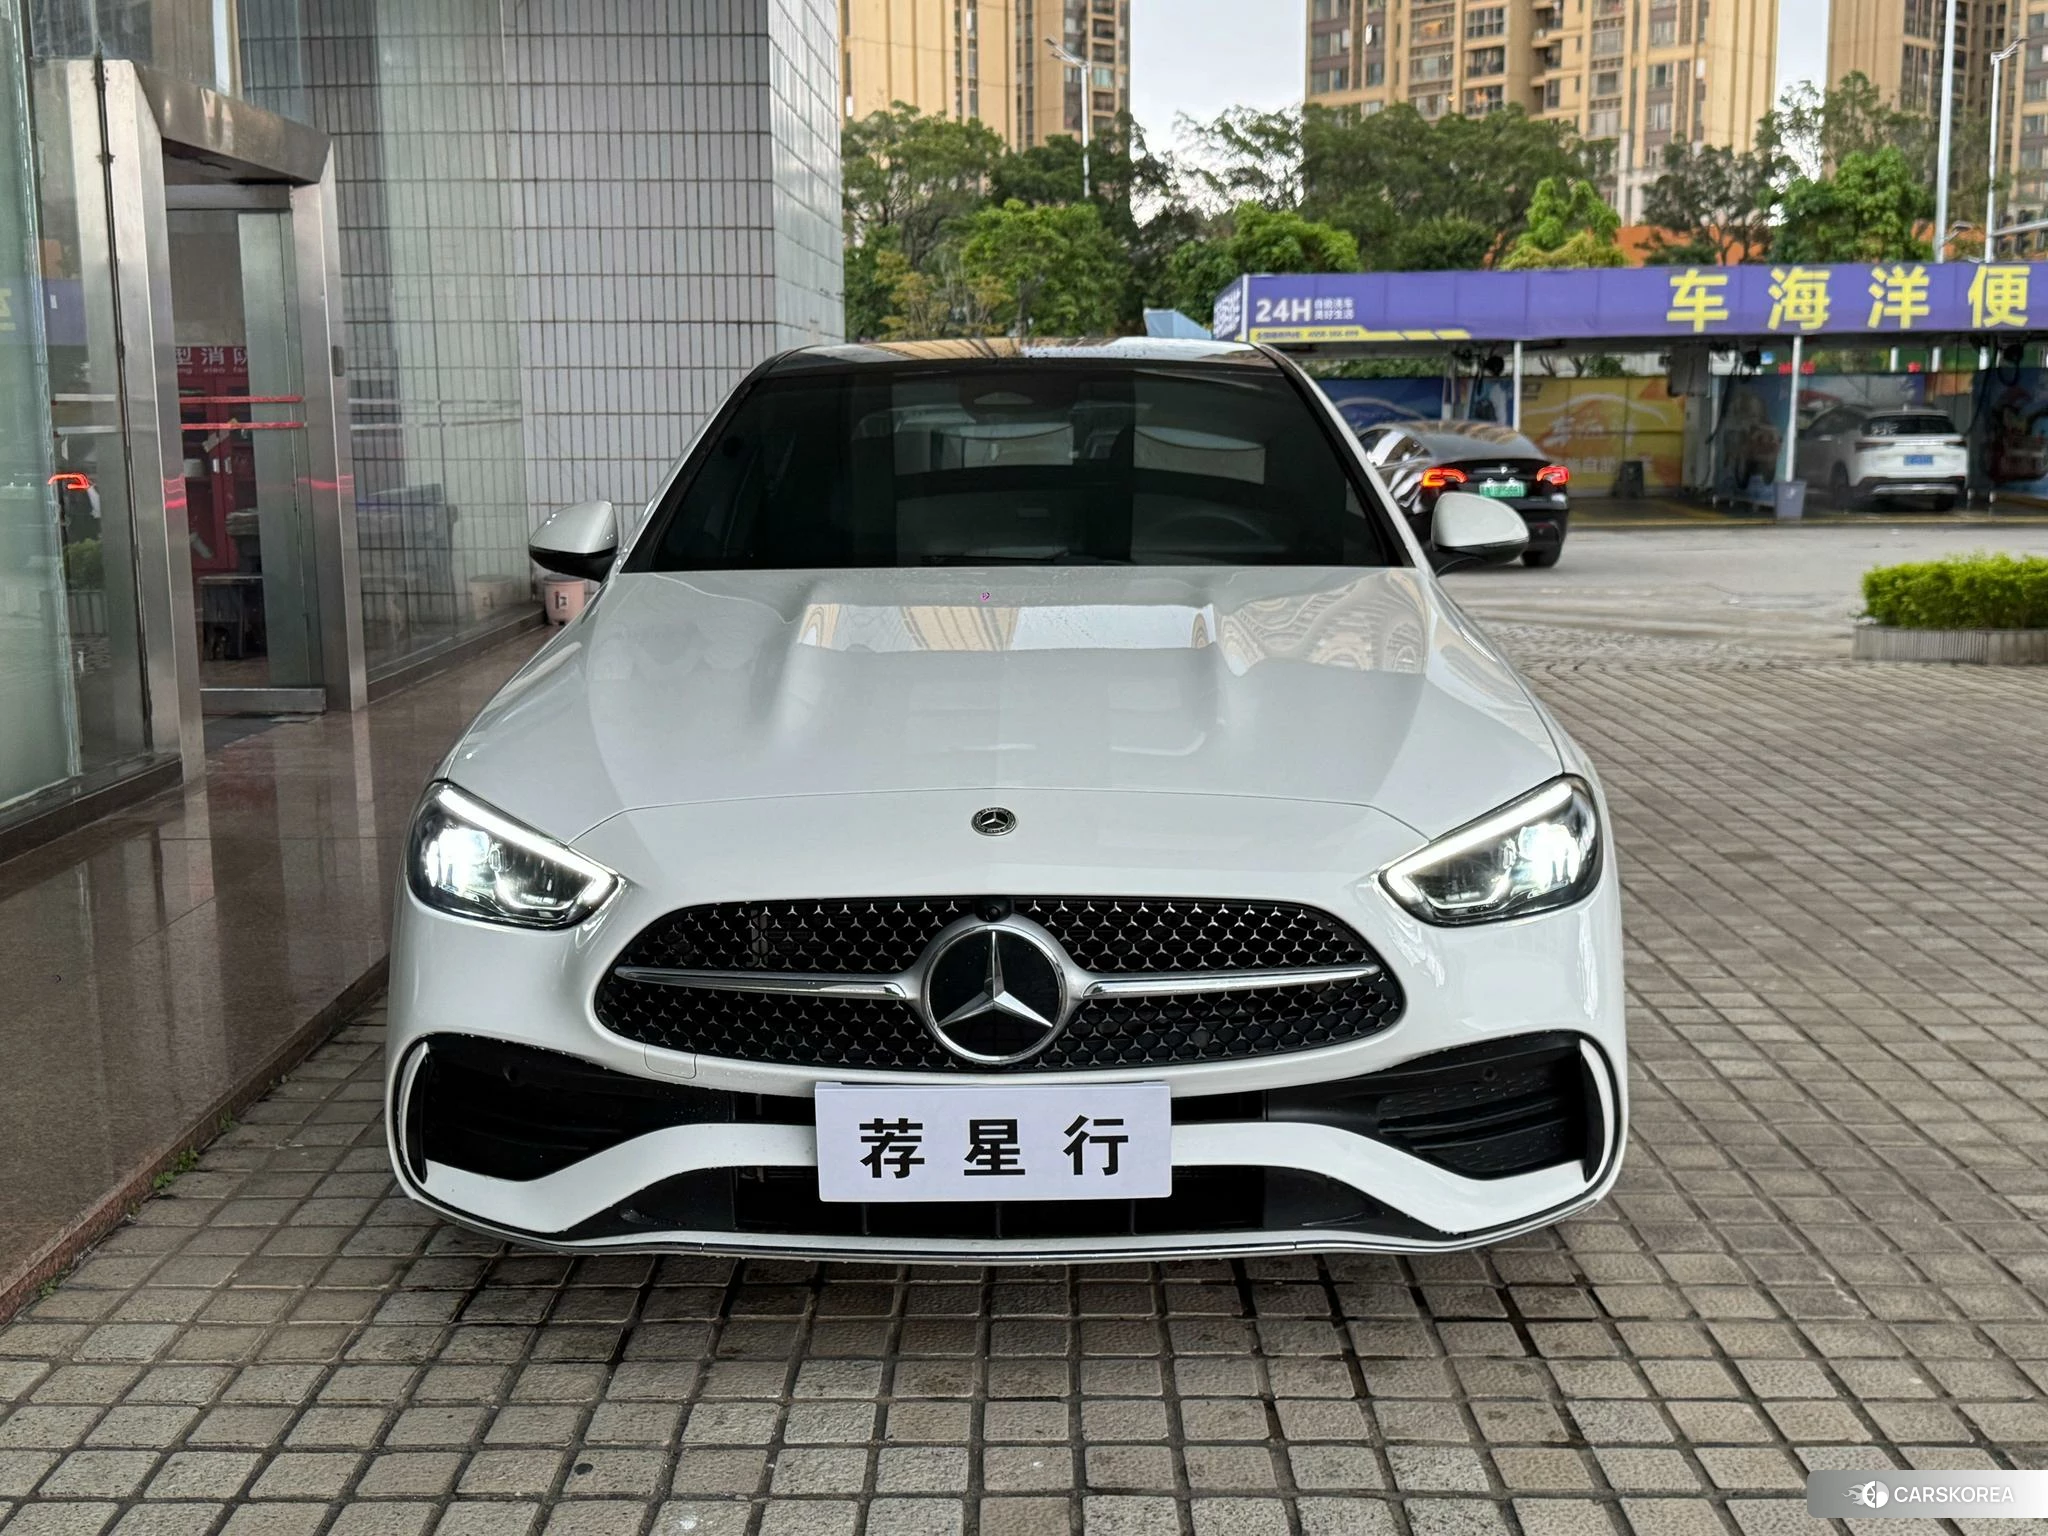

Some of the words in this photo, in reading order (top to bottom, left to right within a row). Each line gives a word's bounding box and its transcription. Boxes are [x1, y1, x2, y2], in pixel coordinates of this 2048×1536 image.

[1255, 298, 1312, 322] 24H
[1667, 265, 2031, 333] 车海洋便
[859, 1114, 1129, 1179] 荐星行
